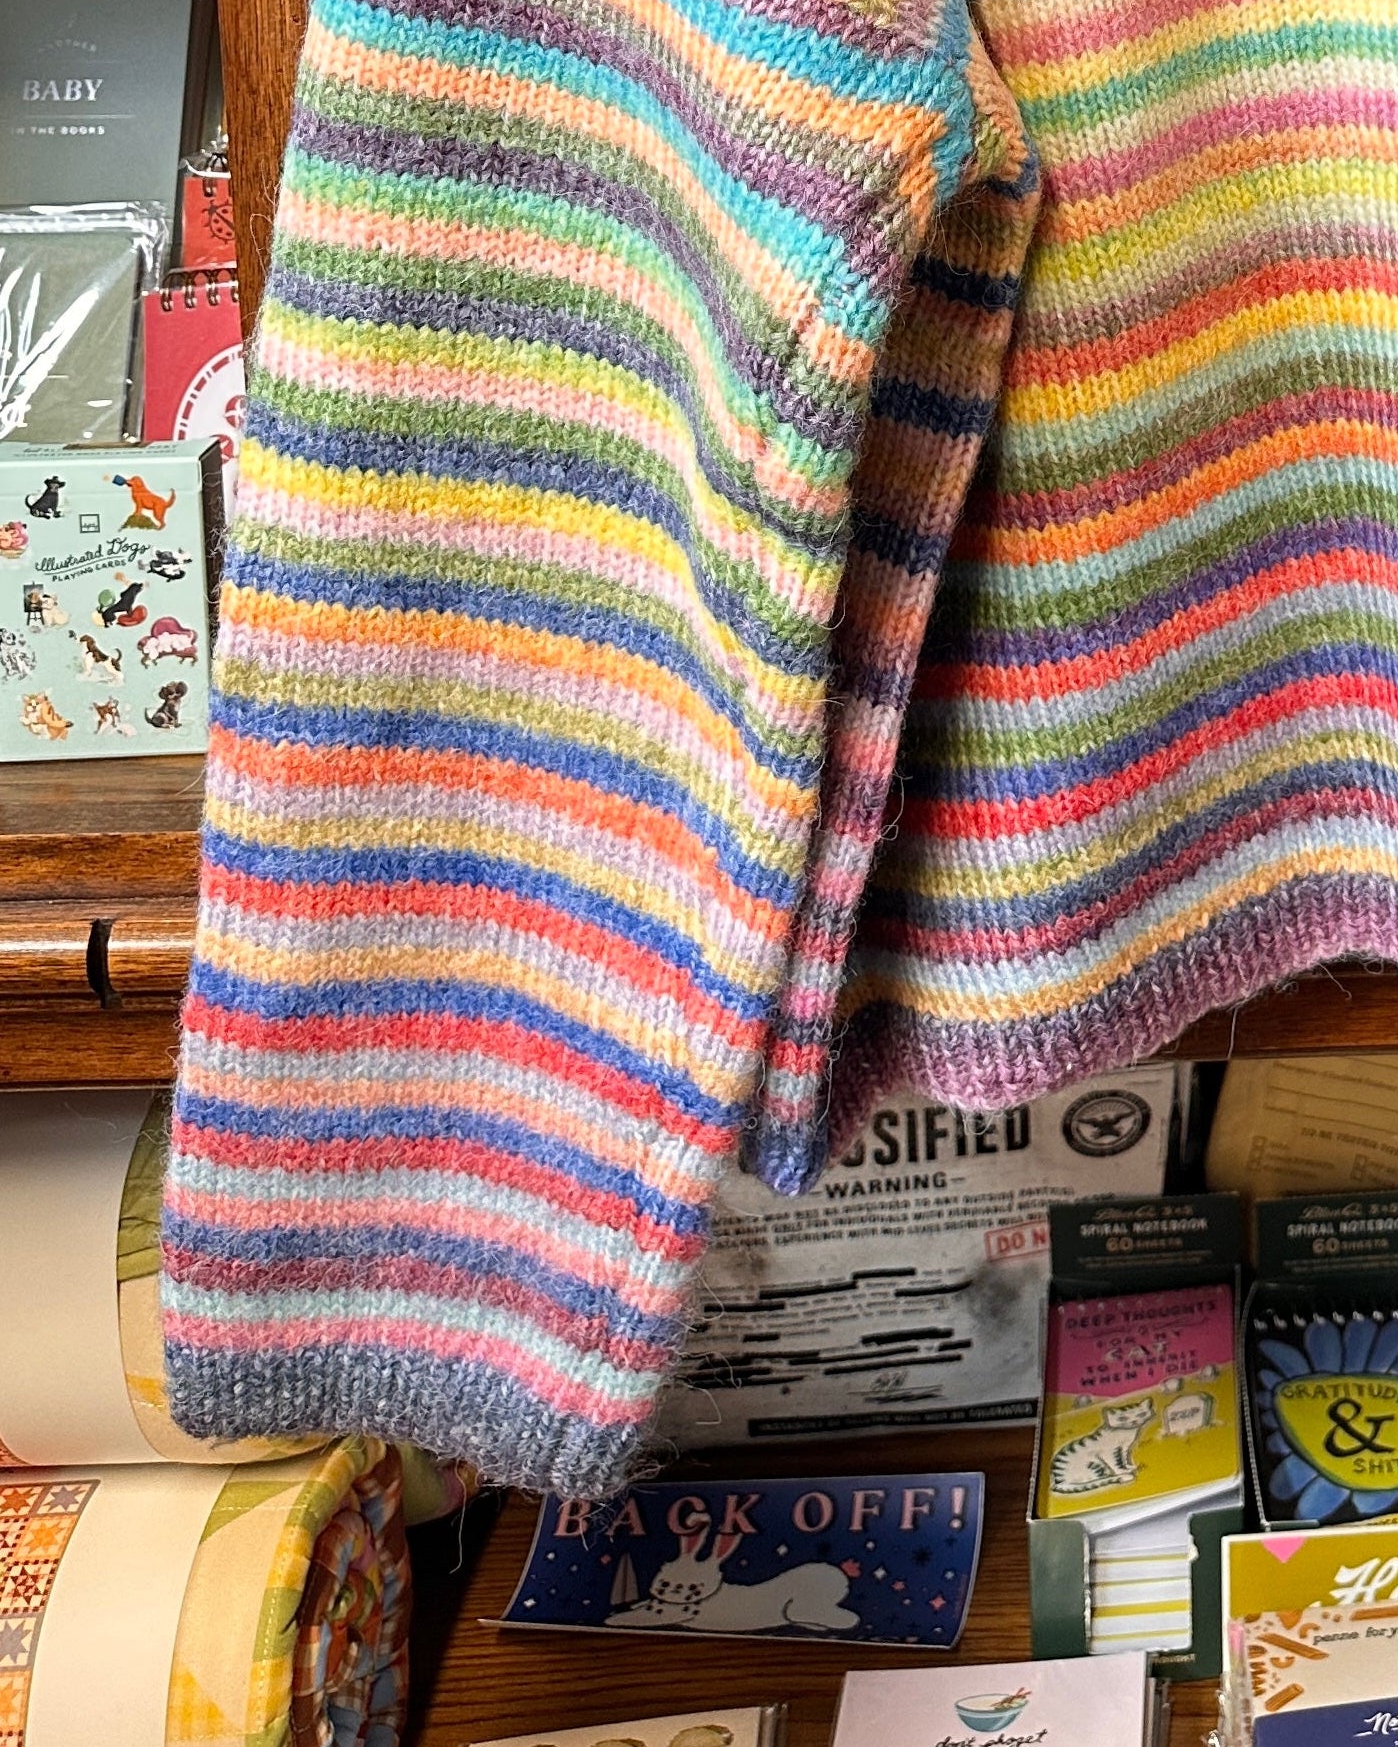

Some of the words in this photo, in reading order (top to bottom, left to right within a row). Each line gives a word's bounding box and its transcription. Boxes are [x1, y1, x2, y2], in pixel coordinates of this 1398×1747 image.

[22, 78, 103, 102] BABY
[35, 544, 105, 573] Illustrated
[107, 537, 151, 562] Dogs
[52, 563, 93, 582] PLAYING
[95, 559, 127, 572] CARDS
[825, 1171, 948, 1201] WARNING
[1133, 1218, 1209, 1234] NOTEBOOK
[998, 1228, 1026, 1252] DO
[1312, 1238, 1341, 1255] 60
[1065, 1312, 1117, 1330] DEEP
[1122, 1301, 1217, 1322] THOUGHTS
[1324, 1397, 1396, 1458] &
[553, 1491, 762, 1538] BACK
[791, 1486, 967, 1534] OFF!
[1313, 1630, 1359, 1646] penne
[1365, 1626, 1386, 1639] for
